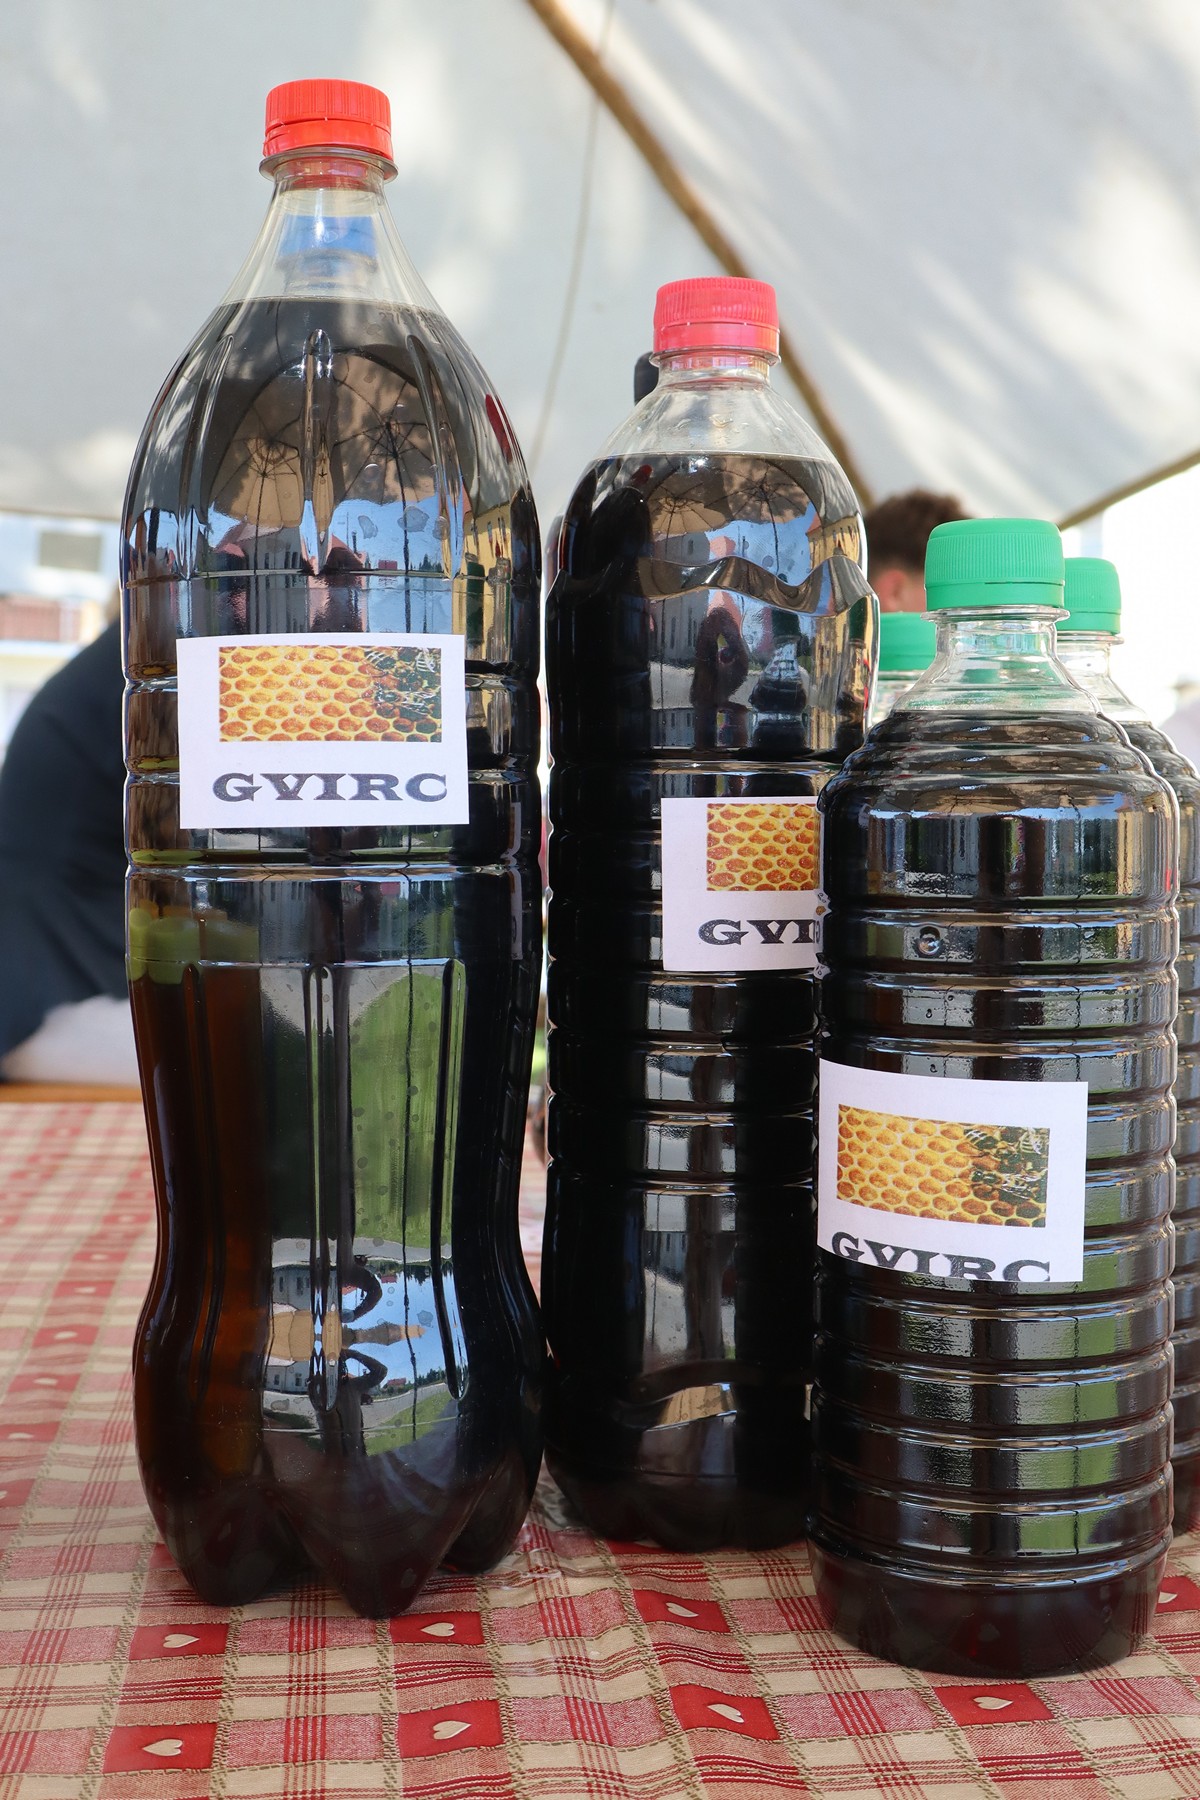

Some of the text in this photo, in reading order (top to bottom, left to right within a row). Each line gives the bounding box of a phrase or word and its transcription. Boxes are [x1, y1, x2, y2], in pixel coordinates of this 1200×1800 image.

[212, 772, 448, 803] GVIRC
[698, 918, 817, 946] GVI
[831, 1231, 1051, 1282] GVIRC
